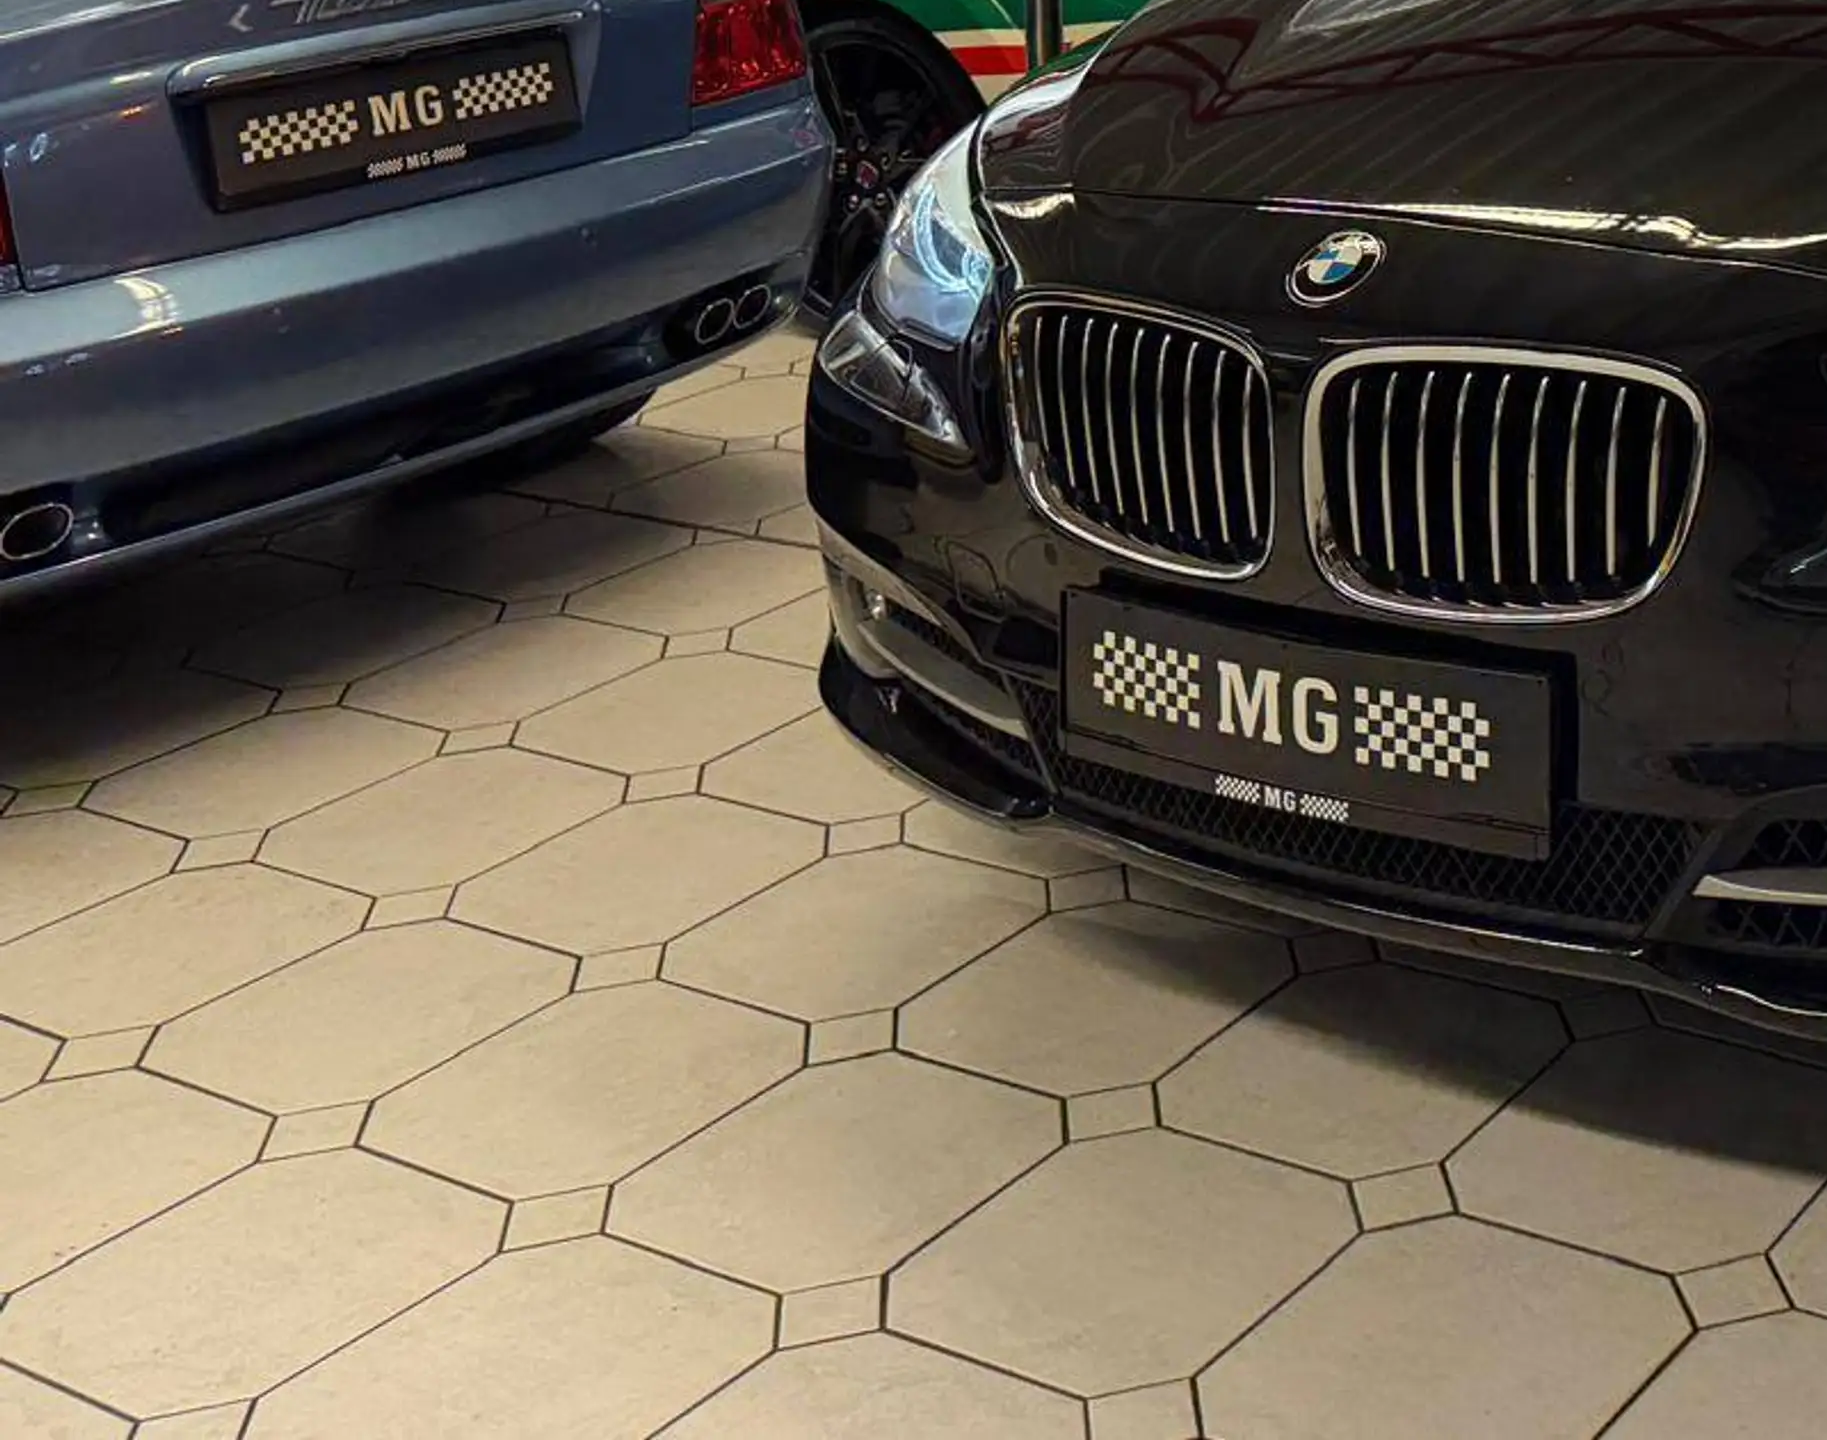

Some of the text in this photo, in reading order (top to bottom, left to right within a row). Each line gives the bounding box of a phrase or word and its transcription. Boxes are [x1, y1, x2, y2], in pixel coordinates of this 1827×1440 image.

[368, 84, 444, 138] MG
[406, 151, 432, 170] MG
[1217, 660, 1339, 755] MG
[1264, 785, 1297, 812] MG
